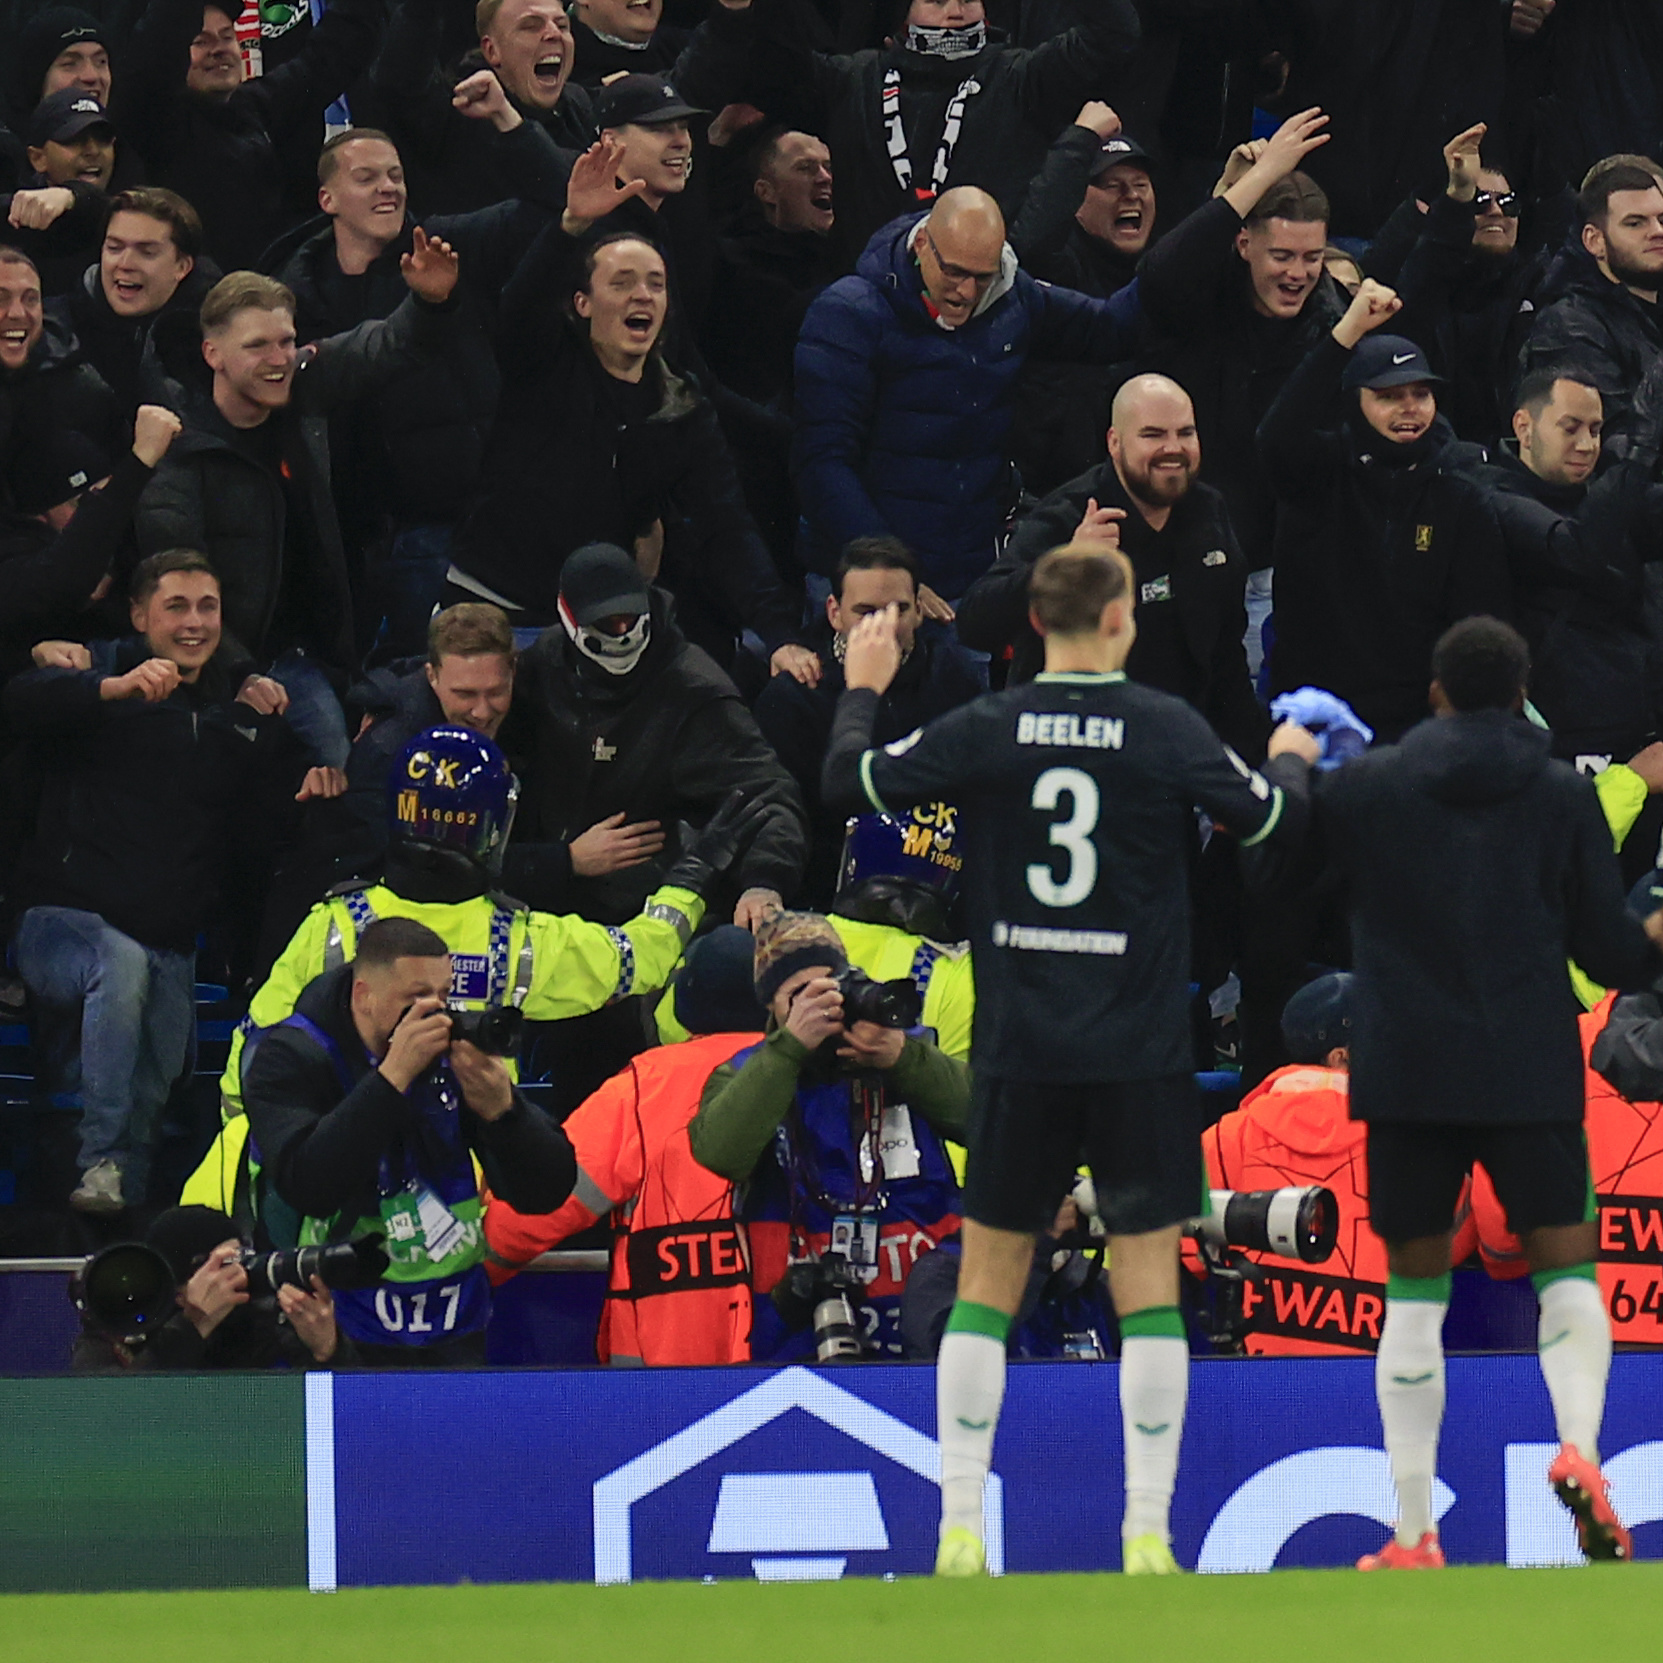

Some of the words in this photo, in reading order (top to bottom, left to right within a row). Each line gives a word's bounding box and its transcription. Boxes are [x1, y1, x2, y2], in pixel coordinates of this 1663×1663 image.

[1016, 711, 1125, 751] BEELEN
[407, 751, 461, 789] CK
[1026, 766, 1100, 908] 3
[374, 1283, 462, 1333] 017
